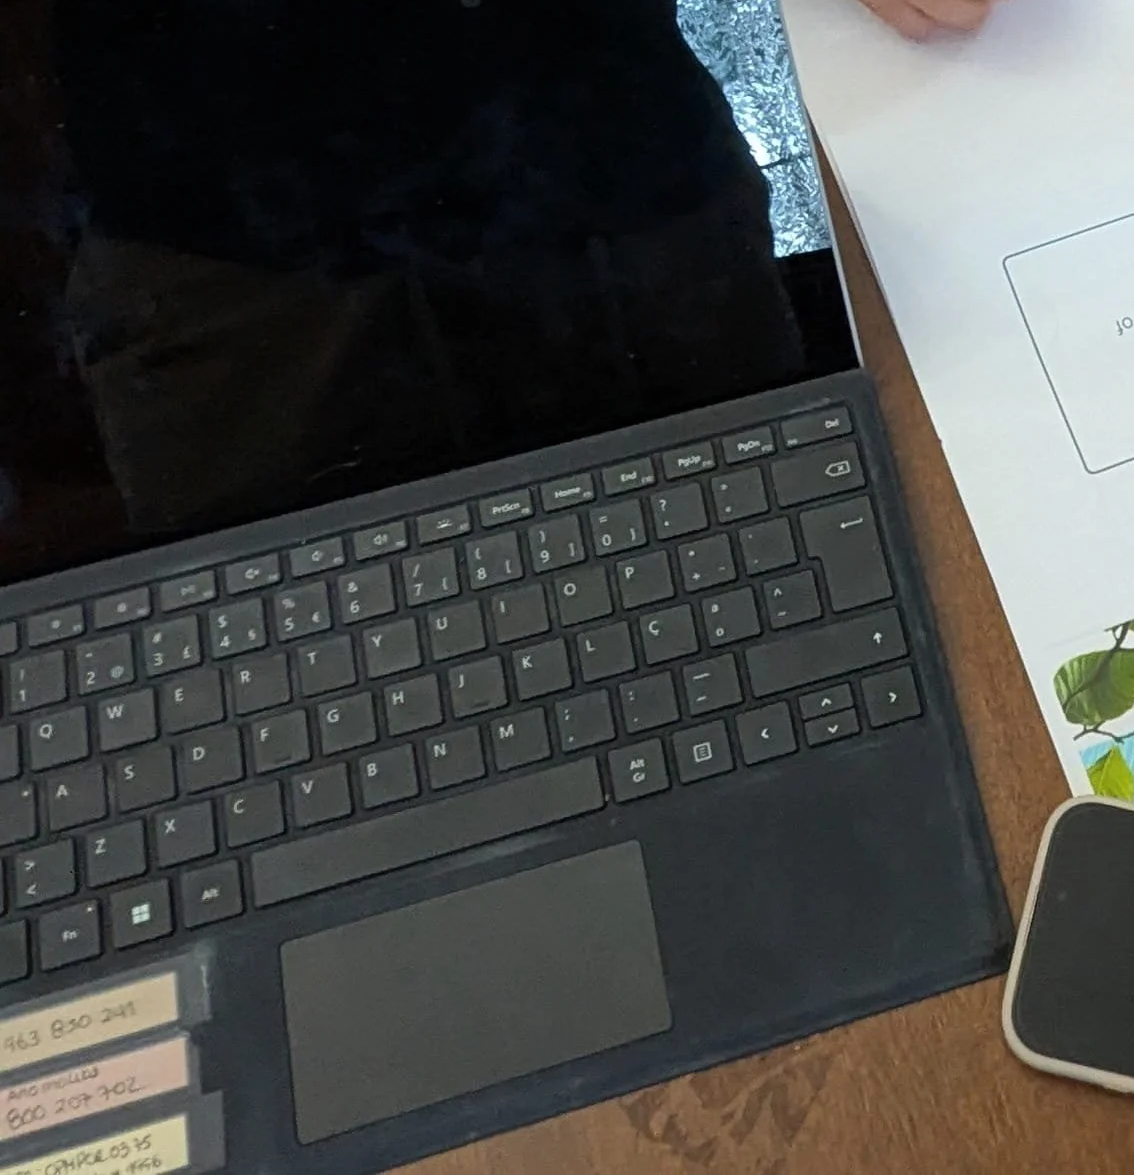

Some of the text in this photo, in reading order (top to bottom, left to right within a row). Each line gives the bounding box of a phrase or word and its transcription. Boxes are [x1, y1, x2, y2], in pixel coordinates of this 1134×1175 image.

[625, 567, 634, 578] P
[564, 583, 576, 595] O
[500, 601, 505, 613] I
[436, 617, 447, 630] U
[372, 635, 381, 647] Y
[308, 652, 316, 665] T
[240, 671, 250, 683] R
[175, 689, 183, 701] E
[107, 705, 122, 719] W
[40, 724, 52, 738] Q
